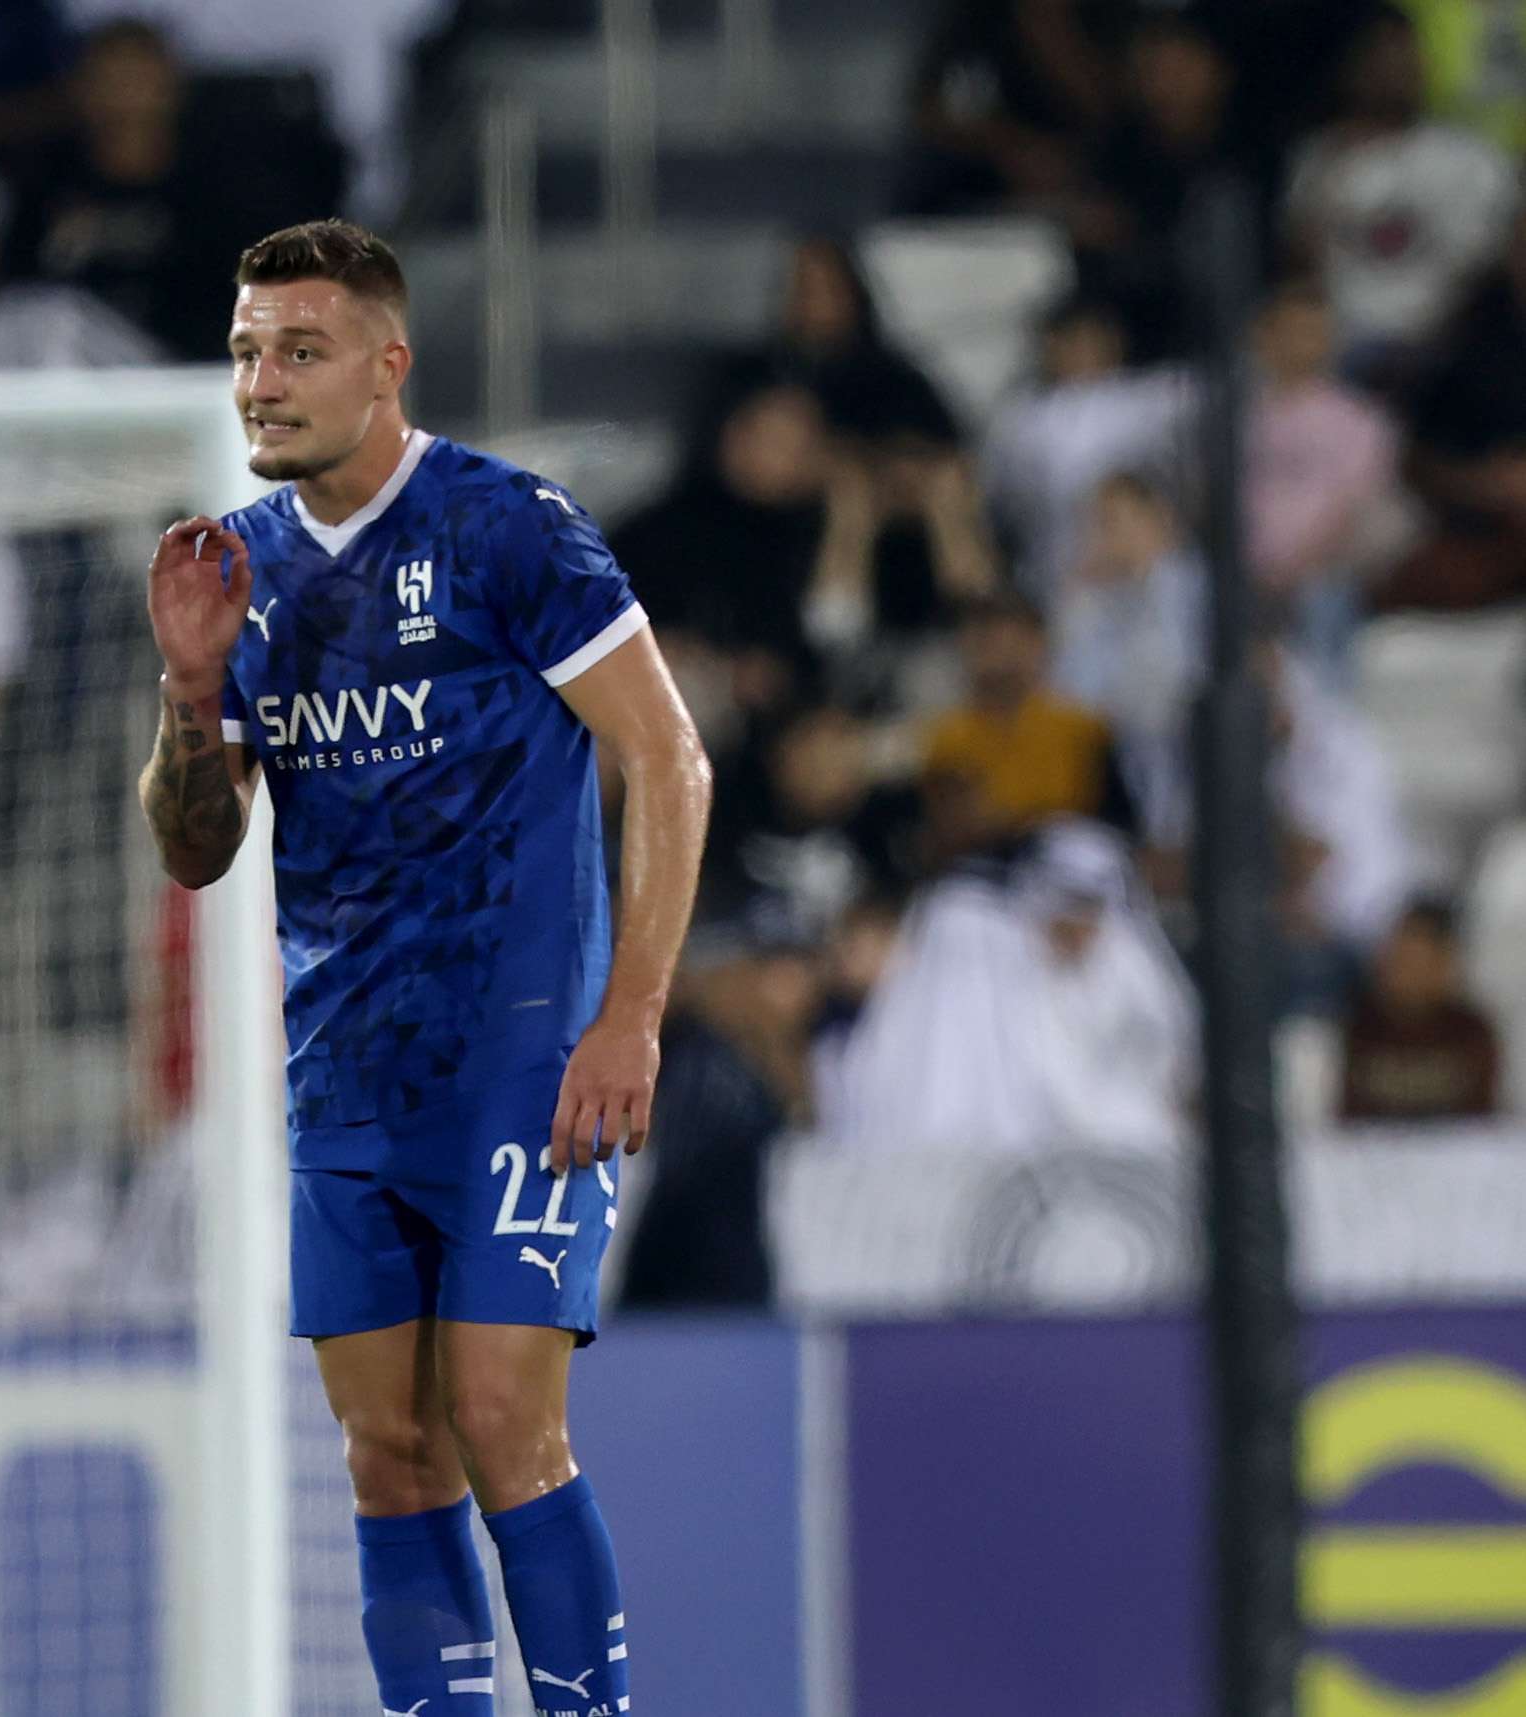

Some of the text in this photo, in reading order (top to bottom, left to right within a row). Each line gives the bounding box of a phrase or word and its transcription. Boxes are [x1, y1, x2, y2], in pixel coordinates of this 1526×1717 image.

[256, 679, 433, 746] SAVVY
[276, 737, 445, 770] GAMES GROUP
[490, 1142, 579, 1236] 22
